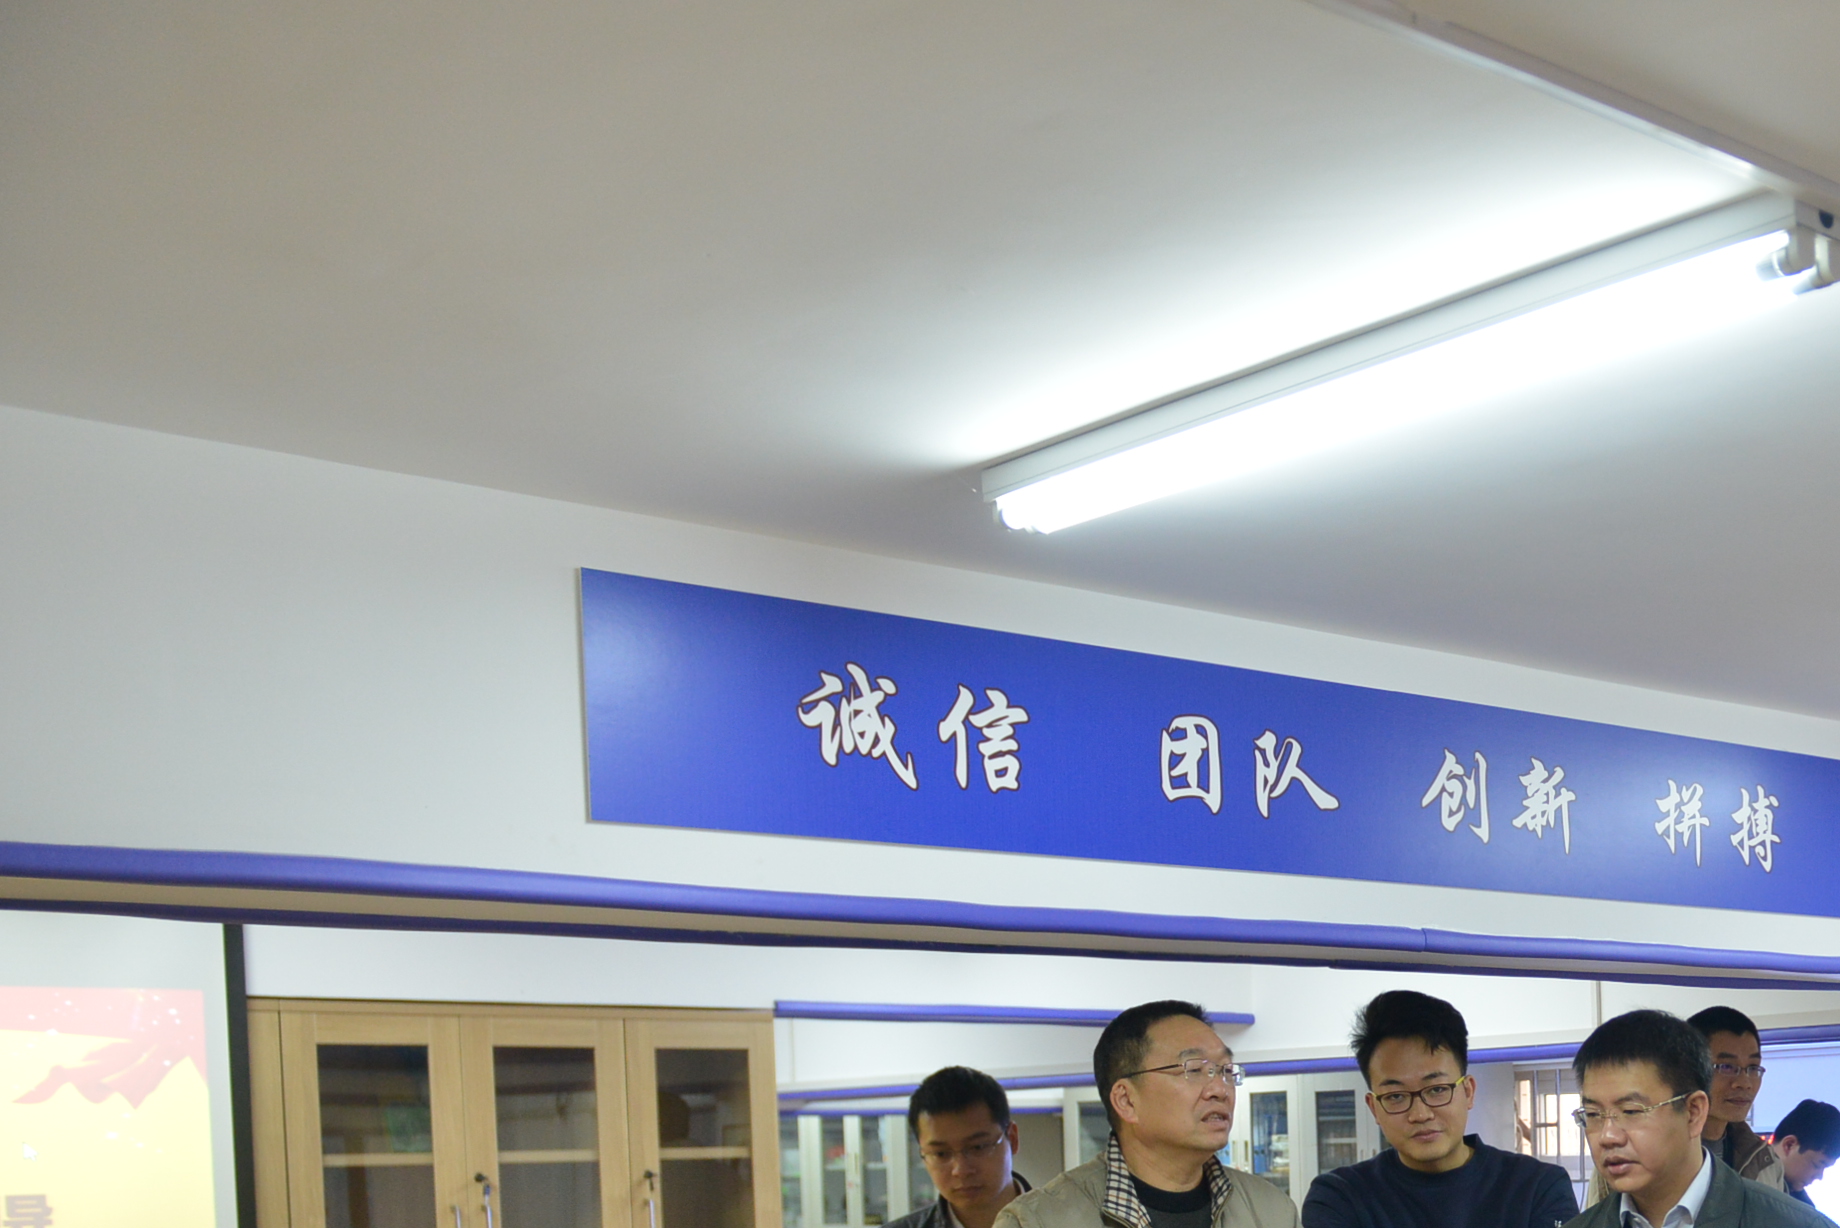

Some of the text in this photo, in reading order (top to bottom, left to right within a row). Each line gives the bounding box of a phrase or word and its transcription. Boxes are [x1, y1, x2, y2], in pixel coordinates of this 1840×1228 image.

[797, 661, 1782, 874] 诚信 团队 创新 拼搏
